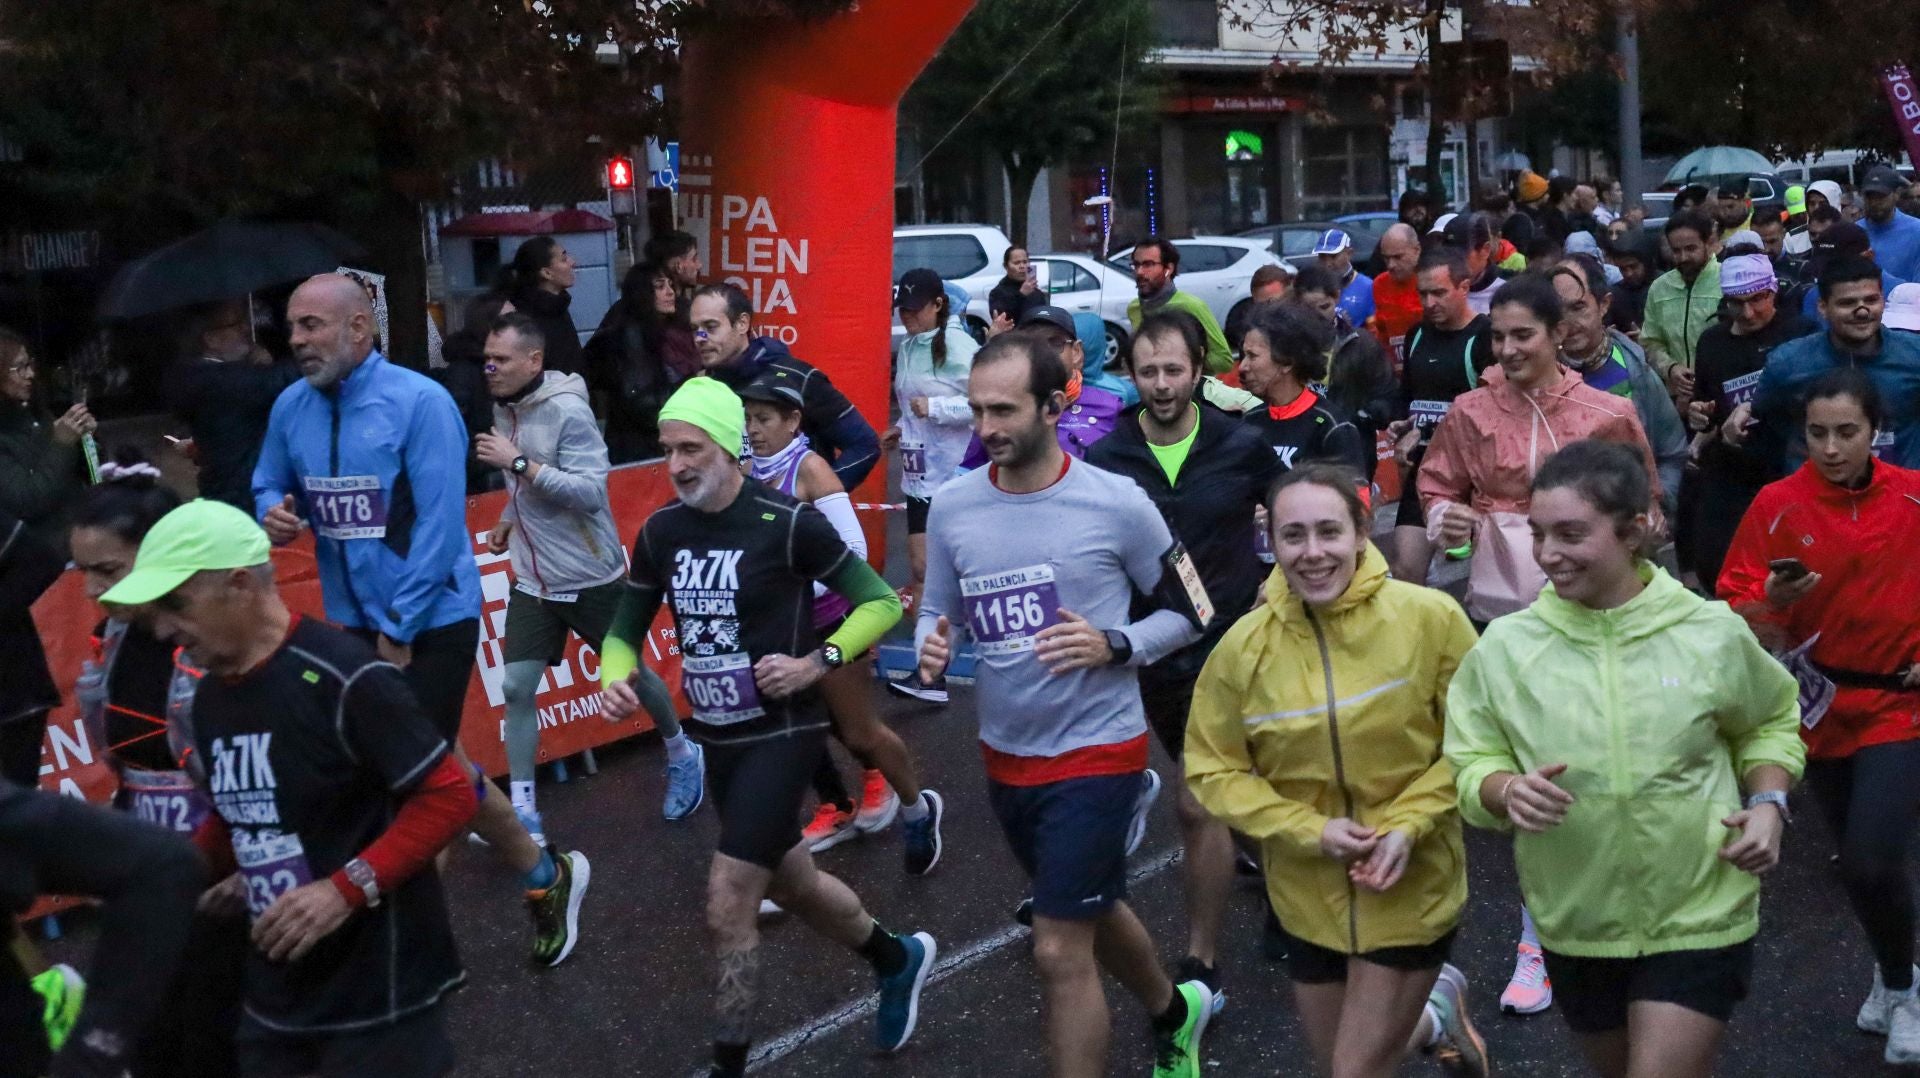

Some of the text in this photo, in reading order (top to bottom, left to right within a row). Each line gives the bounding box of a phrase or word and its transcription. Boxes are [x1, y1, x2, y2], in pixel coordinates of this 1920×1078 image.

[722, 194, 778, 233] PA
[721, 235, 809, 275] LEN
[316, 494, 373, 523] 1178
[671, 549, 744, 590] 3x7K
[982, 572, 1027, 591] PALENCIA
[675, 599, 737, 616] PALENCIA
[974, 592, 1044, 635] 1156
[684, 676, 740, 708] 1063
[209, 732, 277, 794] 3x7K
